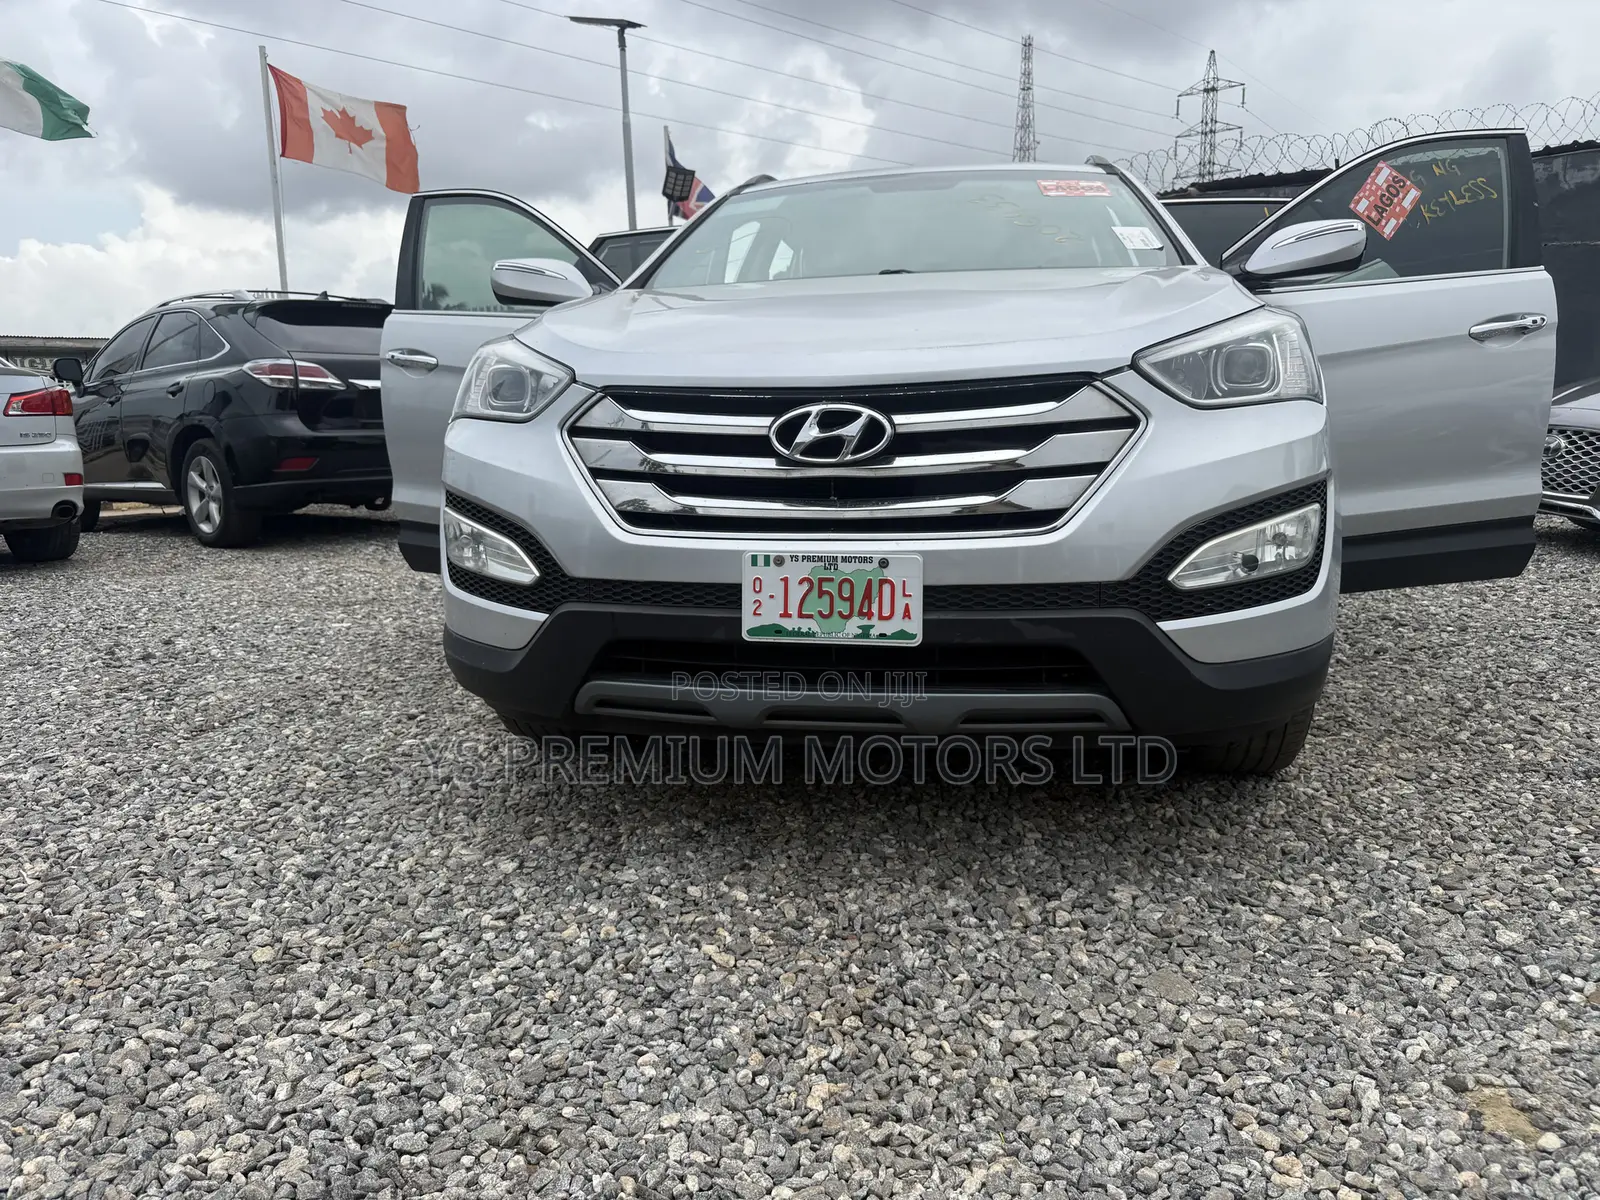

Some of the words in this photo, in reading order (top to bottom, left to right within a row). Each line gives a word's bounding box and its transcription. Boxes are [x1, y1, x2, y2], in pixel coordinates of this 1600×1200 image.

[1366, 175, 1407, 227] LAGOS
[789, 555, 799, 563] YS
[801, 555, 839, 563] PREMIUM
[841, 556, 873, 564] MOTORS
[823, 563, 839, 571] LTD
